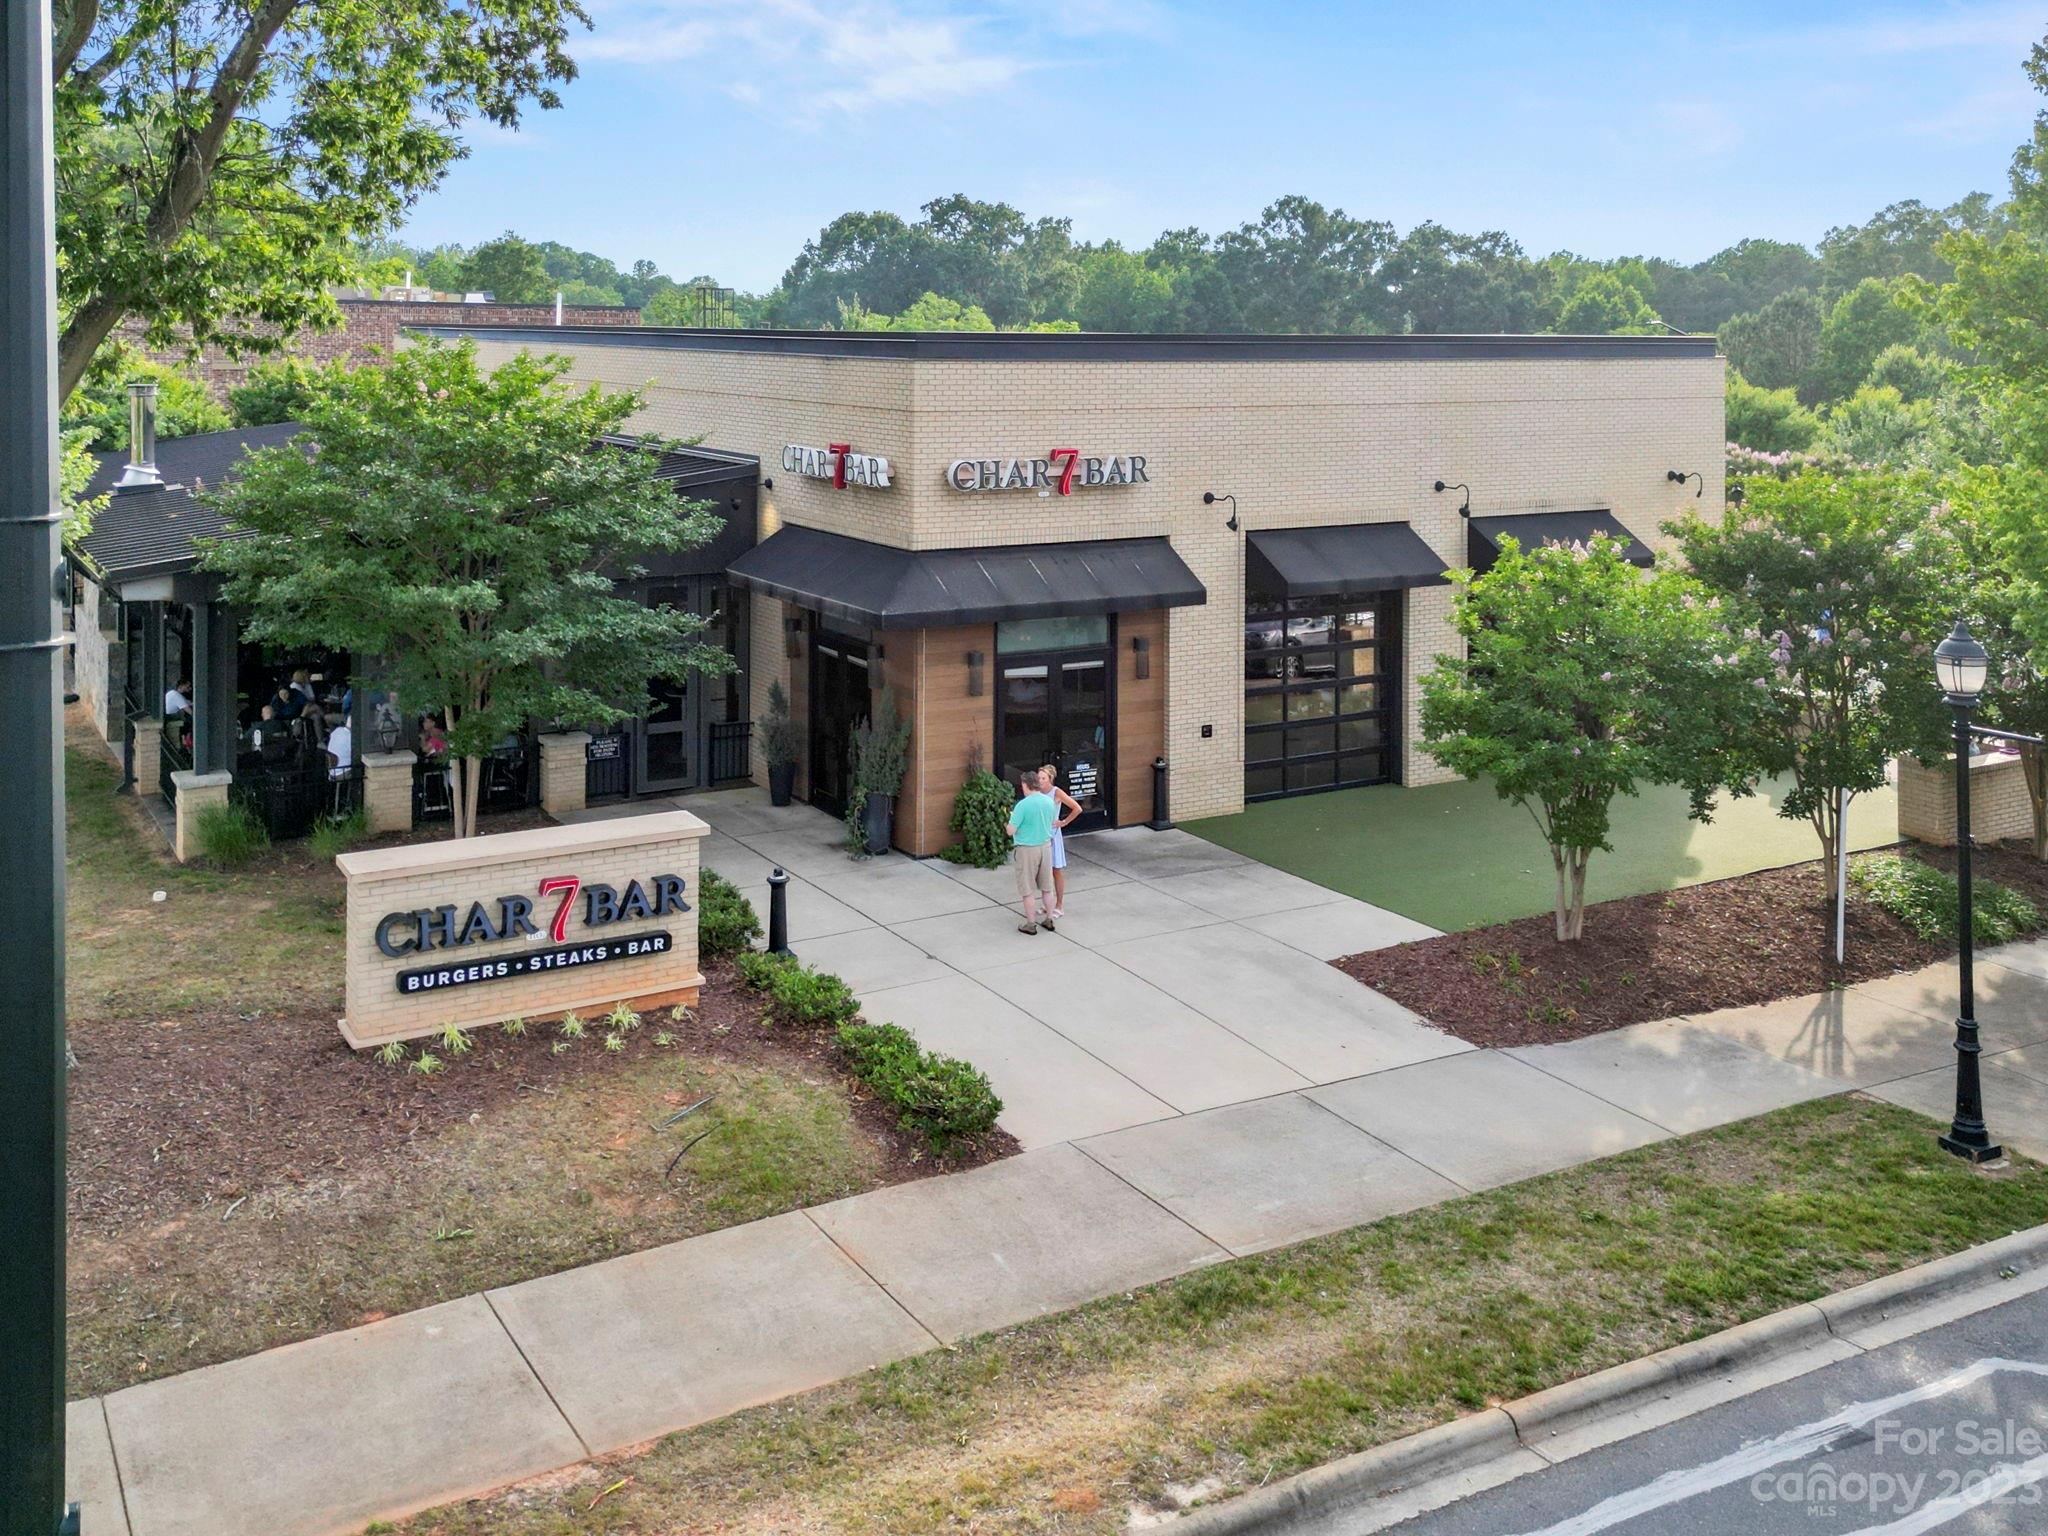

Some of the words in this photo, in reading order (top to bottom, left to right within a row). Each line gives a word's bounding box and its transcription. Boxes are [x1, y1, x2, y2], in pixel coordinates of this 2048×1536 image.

[781, 445, 830, 479] CHAR
[843, 453, 890, 487] BAR
[948, 458, 1053, 491] CHAR
[1050, 448, 1079, 497] 7
[1079, 455, 1151, 488] BAR
[375, 894, 540, 957] CHAR
[538, 875, 582, 944] 7
[582, 873, 692, 928] BAR
[407, 961, 509, 991] BURGERS
[529, 946, 608, 971] STEAKS
[627, 937, 666, 956] BAR
